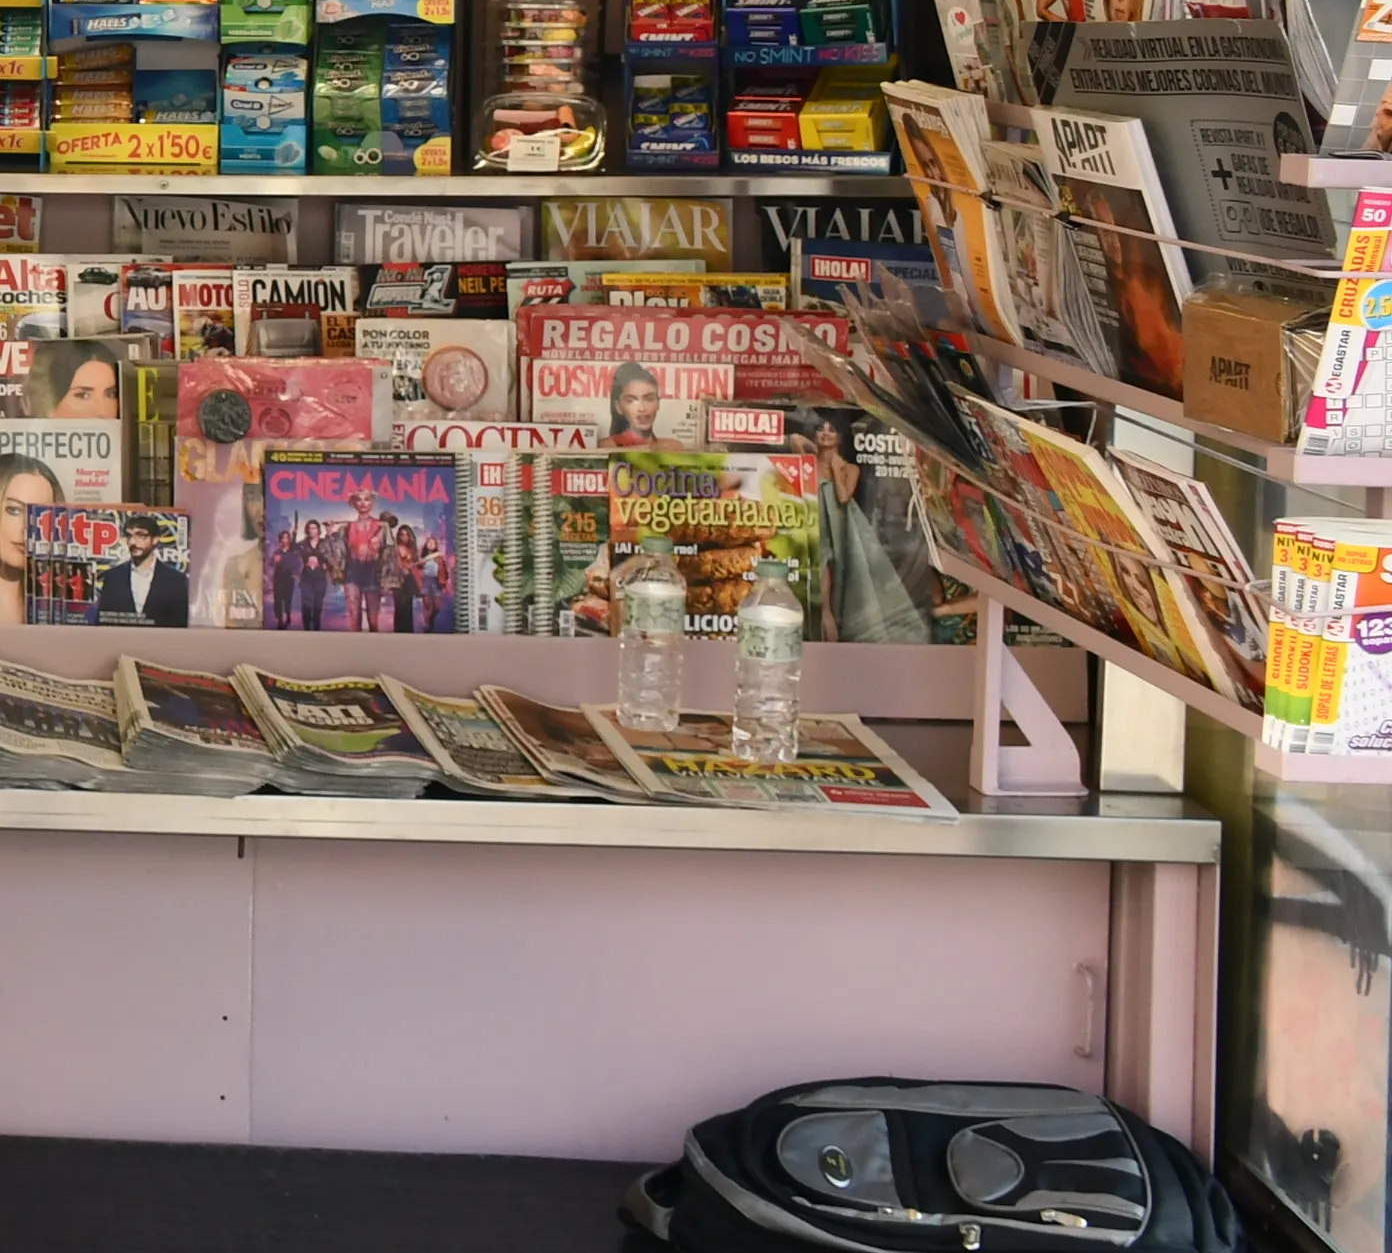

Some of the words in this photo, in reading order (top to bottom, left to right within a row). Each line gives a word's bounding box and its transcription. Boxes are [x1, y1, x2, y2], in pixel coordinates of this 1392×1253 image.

[87, 18, 127, 30] HALLS
[734, 51, 757, 63] NO
[759, 47, 816, 65] SMINT
[843, 43, 881, 62] KISS
[1090, 37, 1137, 59] REALIDAD
[1138, 36, 1189, 59] VIRTUAL
[1070, 67, 1104, 90] ENTRA
[1134, 69, 1193, 93] MEJORES
[1192, 69, 1243, 93] COCINAS
[56, 131, 123, 156] OFERTA
[1050, 117, 1108, 152] APART
[733, 153, 758, 163] LOS
[760, 153, 799, 165] BESOS
[801, 152, 828, 166] MÁS
[830, 155, 887, 168] FRESCOS
[121, 199, 207, 231] Nuevo
[212, 202, 293, 235] Estilo
[384, 209, 422, 223] Condé
[424, 211, 454, 225] Nast
[545, 200, 727, 254] VIAJAR
[1361, 208, 1387, 223] 50
[357, 209, 505, 264] Traveler
[814, 258, 867, 279] ¡HOLA!
[458, 277, 487, 293] NEIL
[526, 284, 564, 297] RUTA
[362, 329, 387, 339] PON
[389, 329, 430, 340] COLOR
[542, 319, 691, 351] REGALO
[669, 352, 716, 362] SELLER
[721, 354, 768, 364] MEGAN
[714, 411, 778, 435] ¡HOLA!
[269, 469, 450, 503] CINEMANÍA
[612, 461, 721, 499] Cocina
[561, 512, 598, 532] 215
[616, 495, 804, 532] vegetariana
[70, 513, 119, 556] tp
[1296, 640, 1314, 690] SUDOKU
[1326, 645, 1339, 675] LETRAS
[1325, 675, 1336, 691] DE
[1315, 691, 1333, 720] SOPAS
